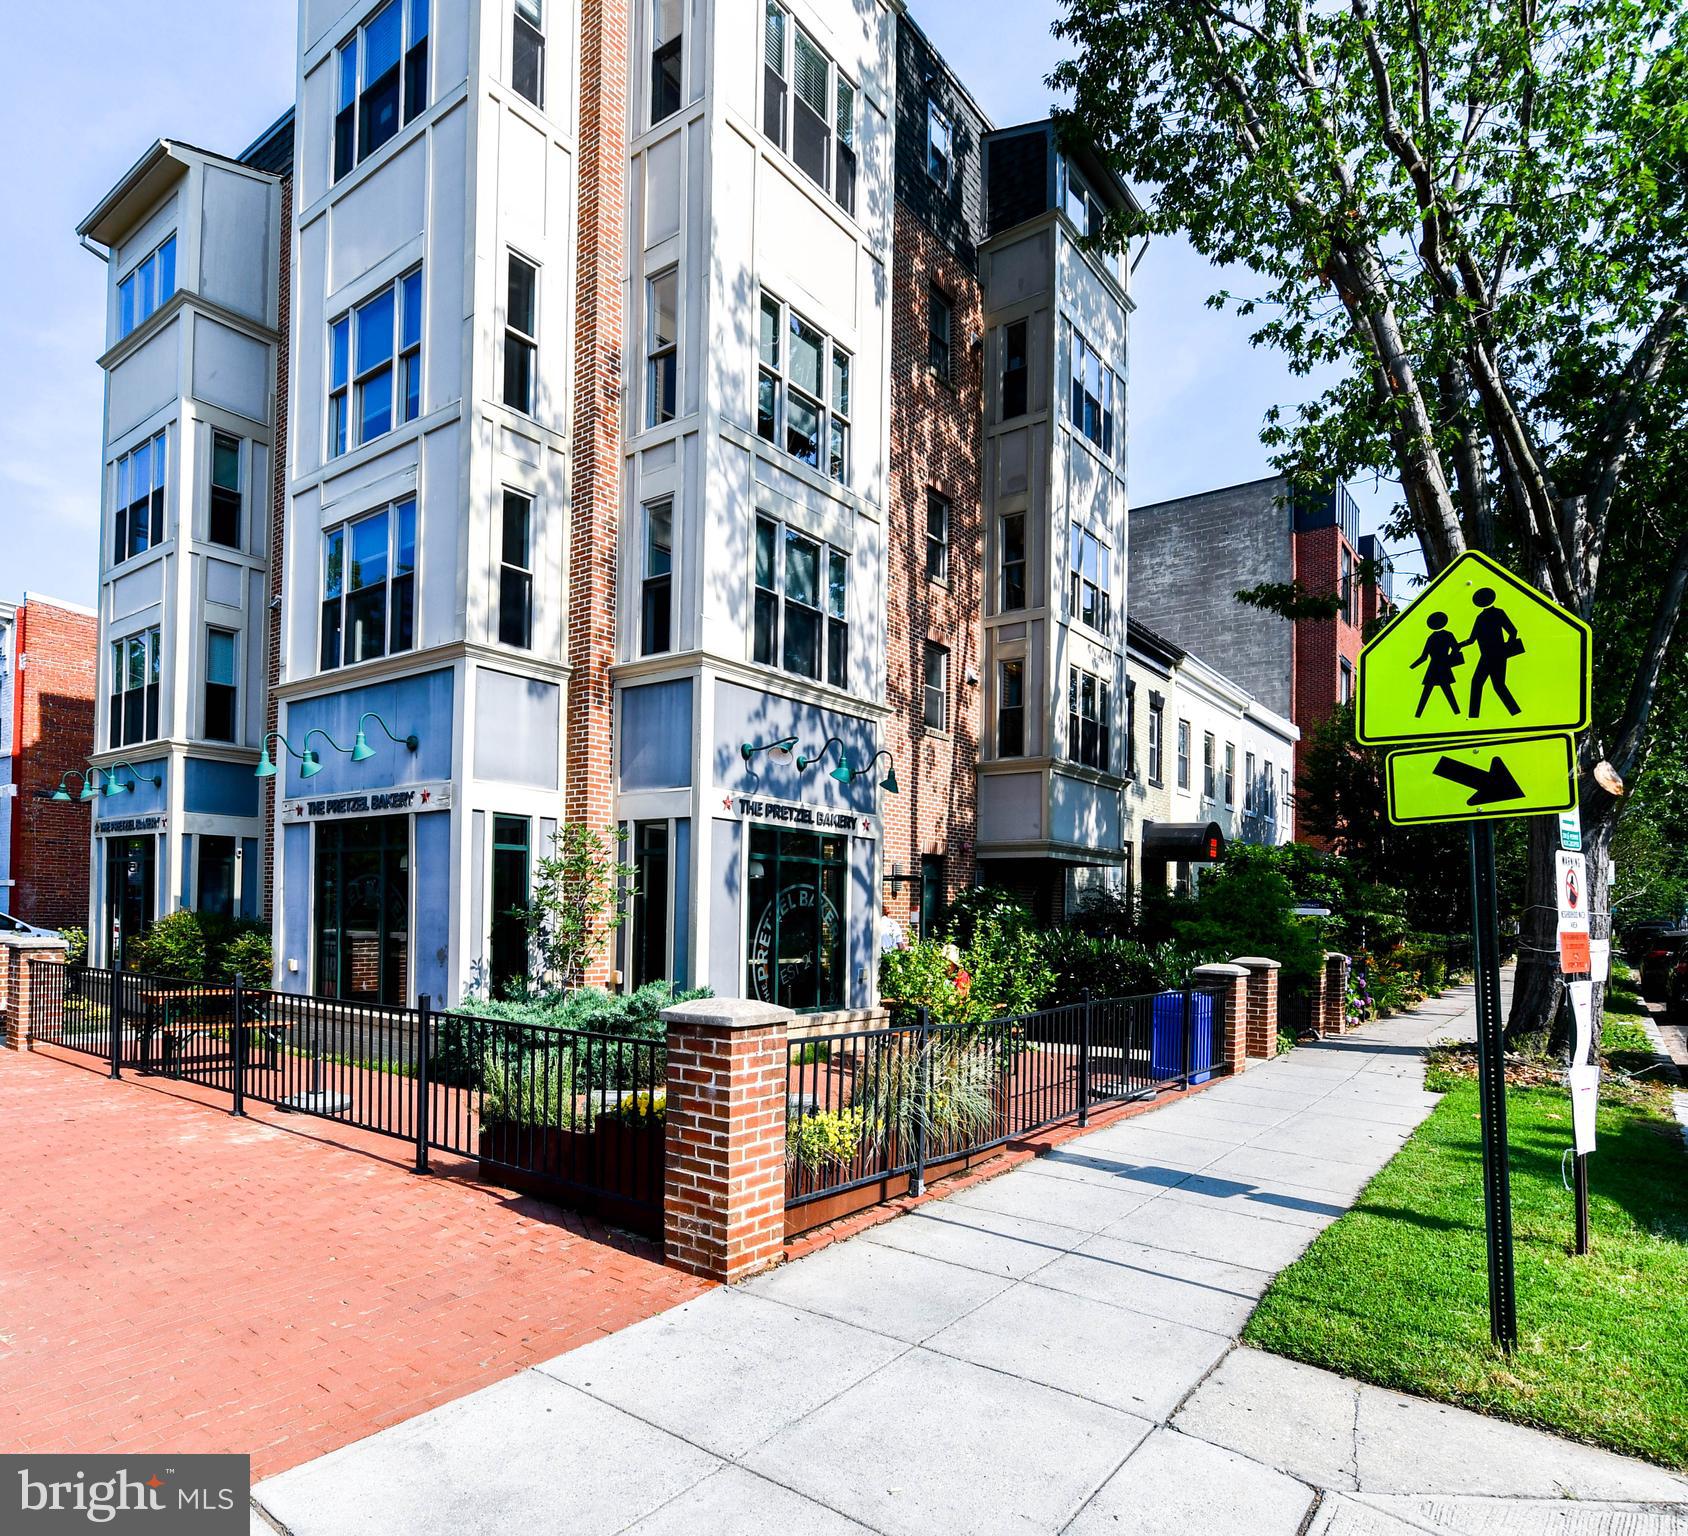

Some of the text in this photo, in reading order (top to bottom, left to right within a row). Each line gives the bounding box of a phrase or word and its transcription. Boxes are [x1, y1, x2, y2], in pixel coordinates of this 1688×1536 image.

[307, 790, 416, 816] THE PRETZEL BAKERY
[739, 798, 858, 831] THE PRETZEL BAKERY
